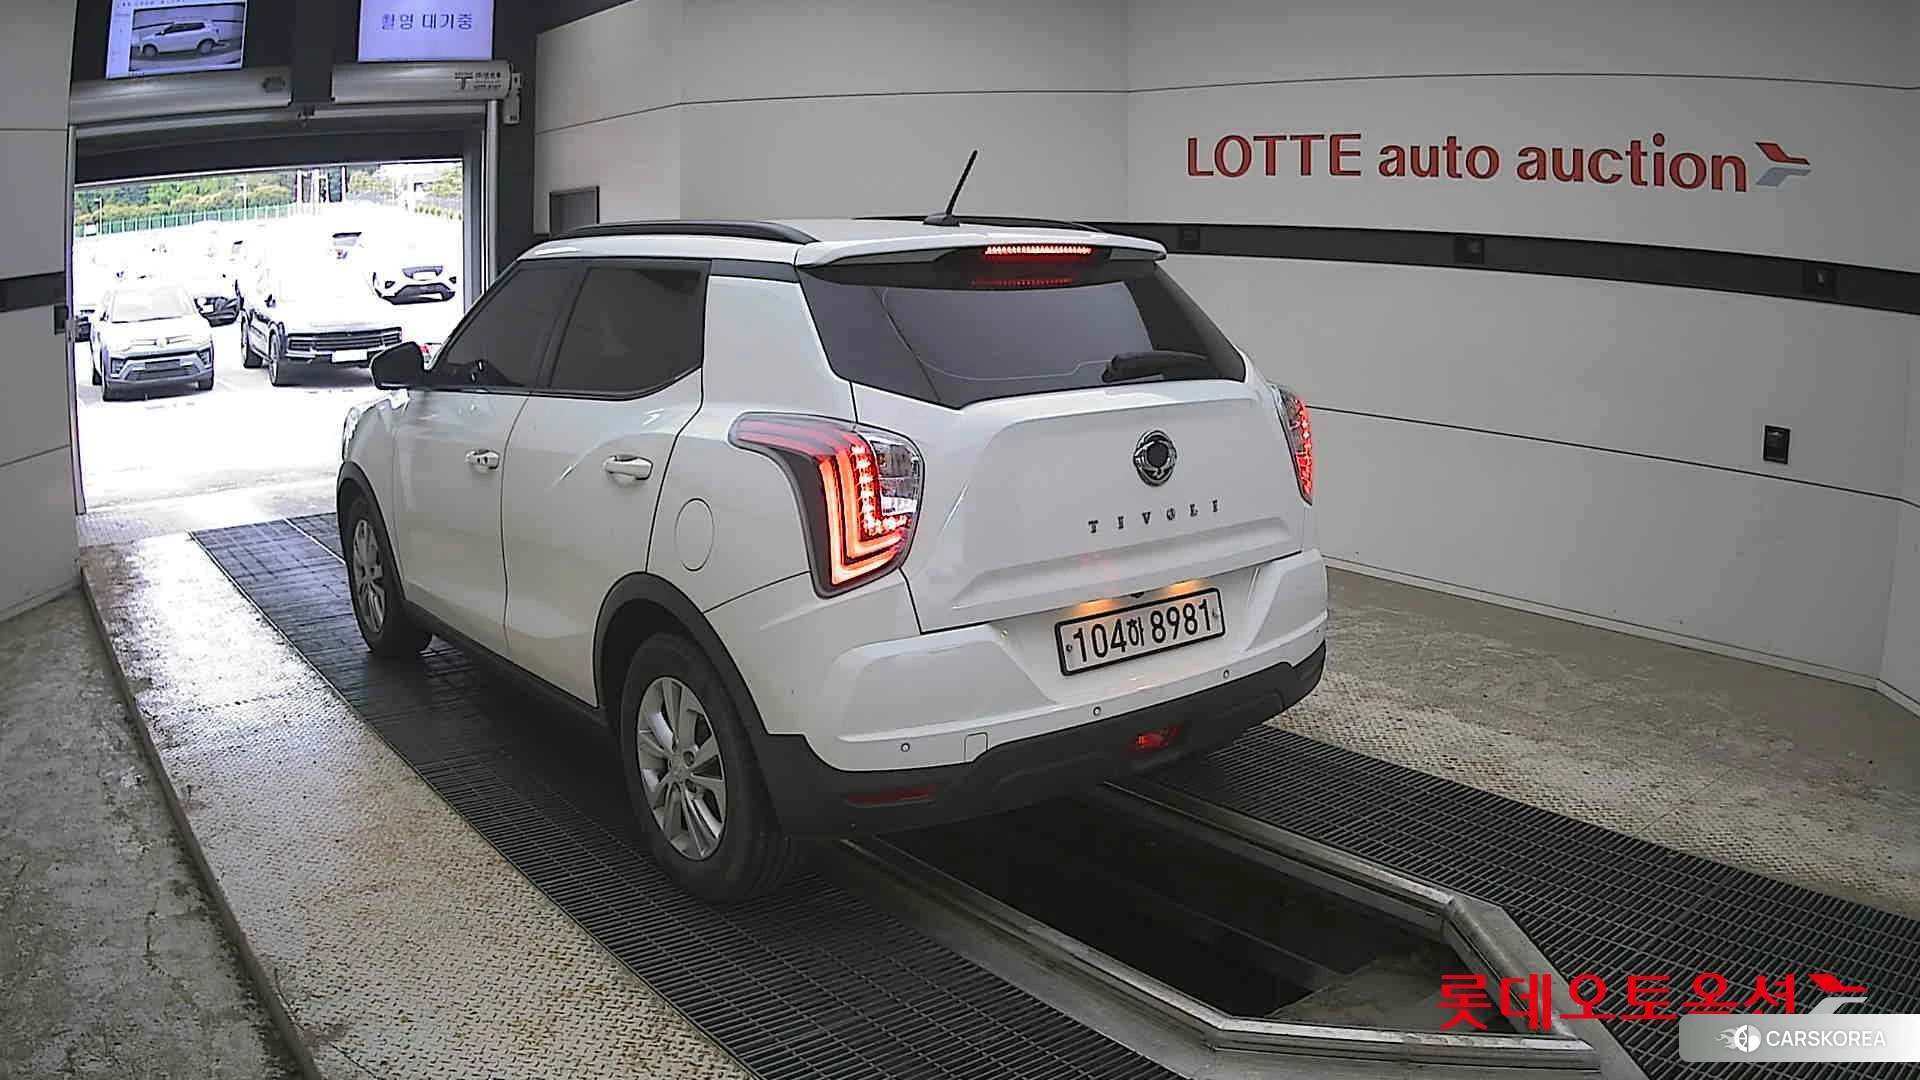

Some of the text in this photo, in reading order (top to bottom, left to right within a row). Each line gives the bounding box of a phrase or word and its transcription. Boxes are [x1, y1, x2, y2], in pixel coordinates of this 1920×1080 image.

[422, 13, 473, 31] 대기중
[1186, 132, 1747, 193] LOTTE auto auction
[1087, 499, 1219, 534] TIVOLI
[1072, 599, 1212, 663] 104하 8981
